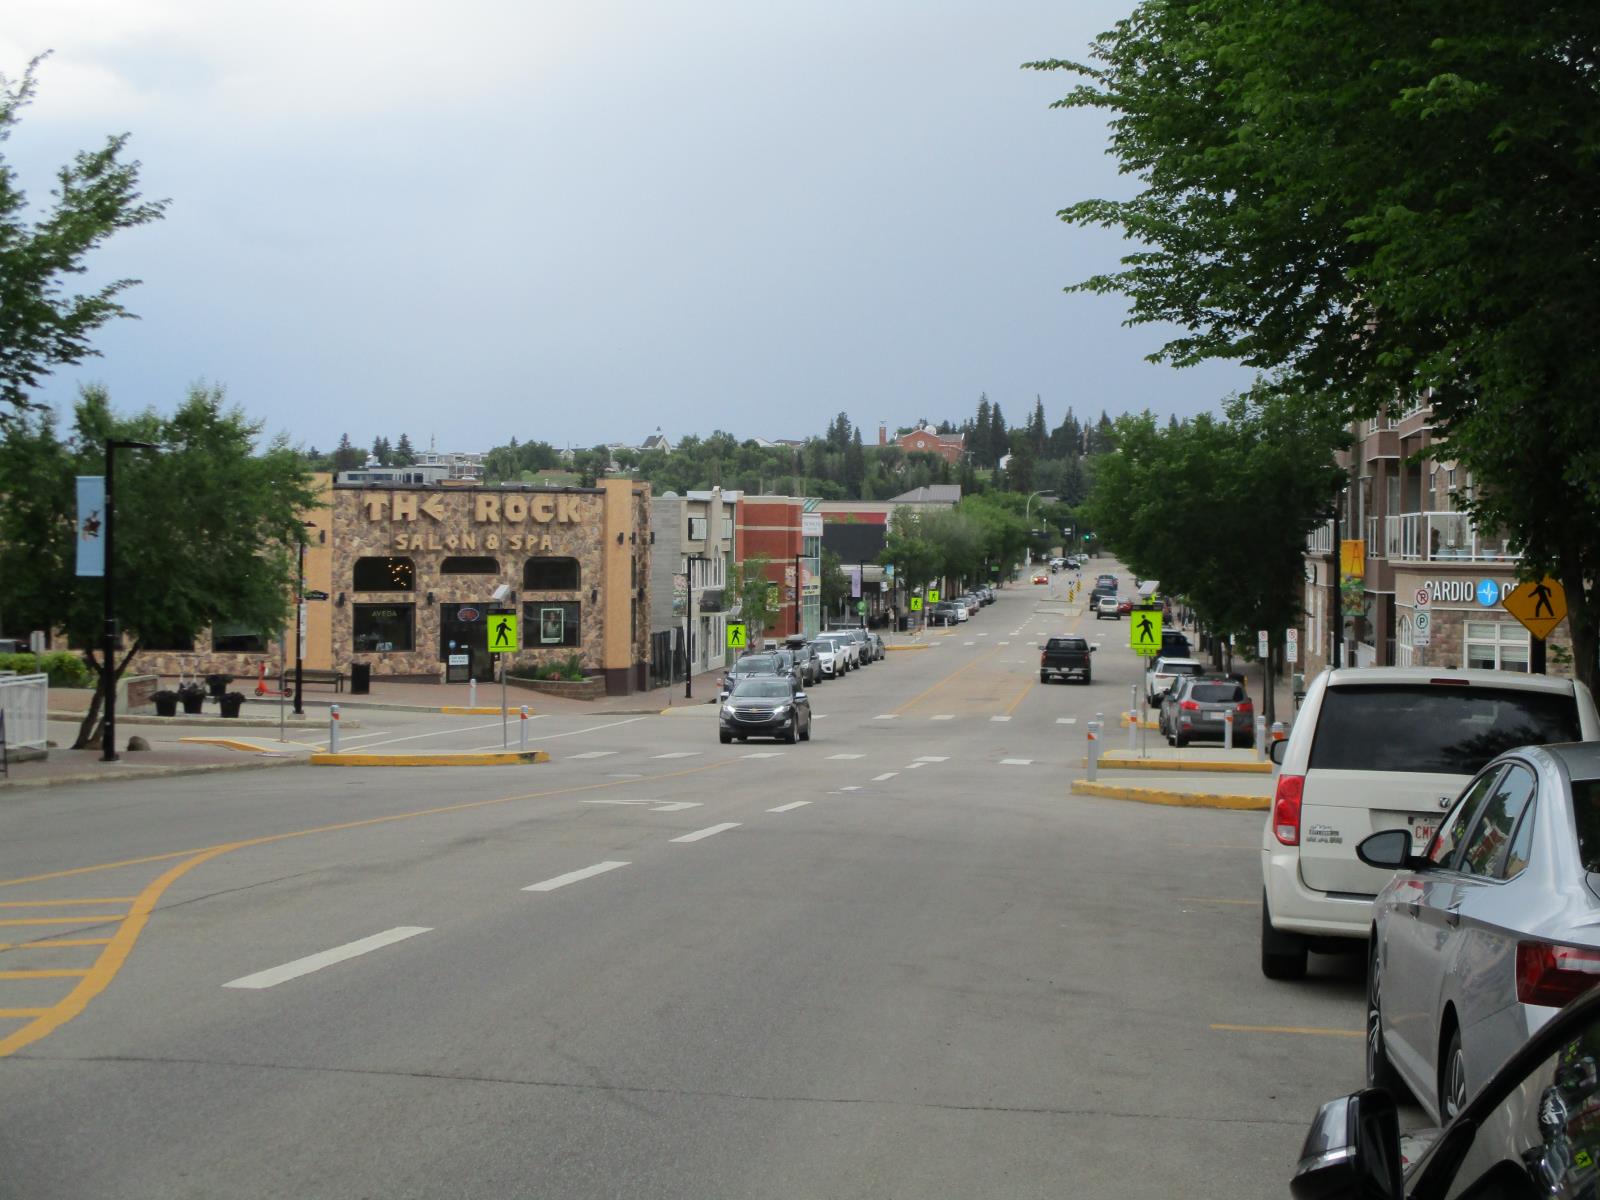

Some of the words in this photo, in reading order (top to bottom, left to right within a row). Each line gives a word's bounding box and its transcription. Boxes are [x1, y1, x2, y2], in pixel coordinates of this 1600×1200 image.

[364, 493, 445, 521] THE
[475, 495, 581, 523] ROCK
[395, 534, 475, 550] SALON
[486, 534, 499, 550] &
[508, 534, 552, 551] SPA
